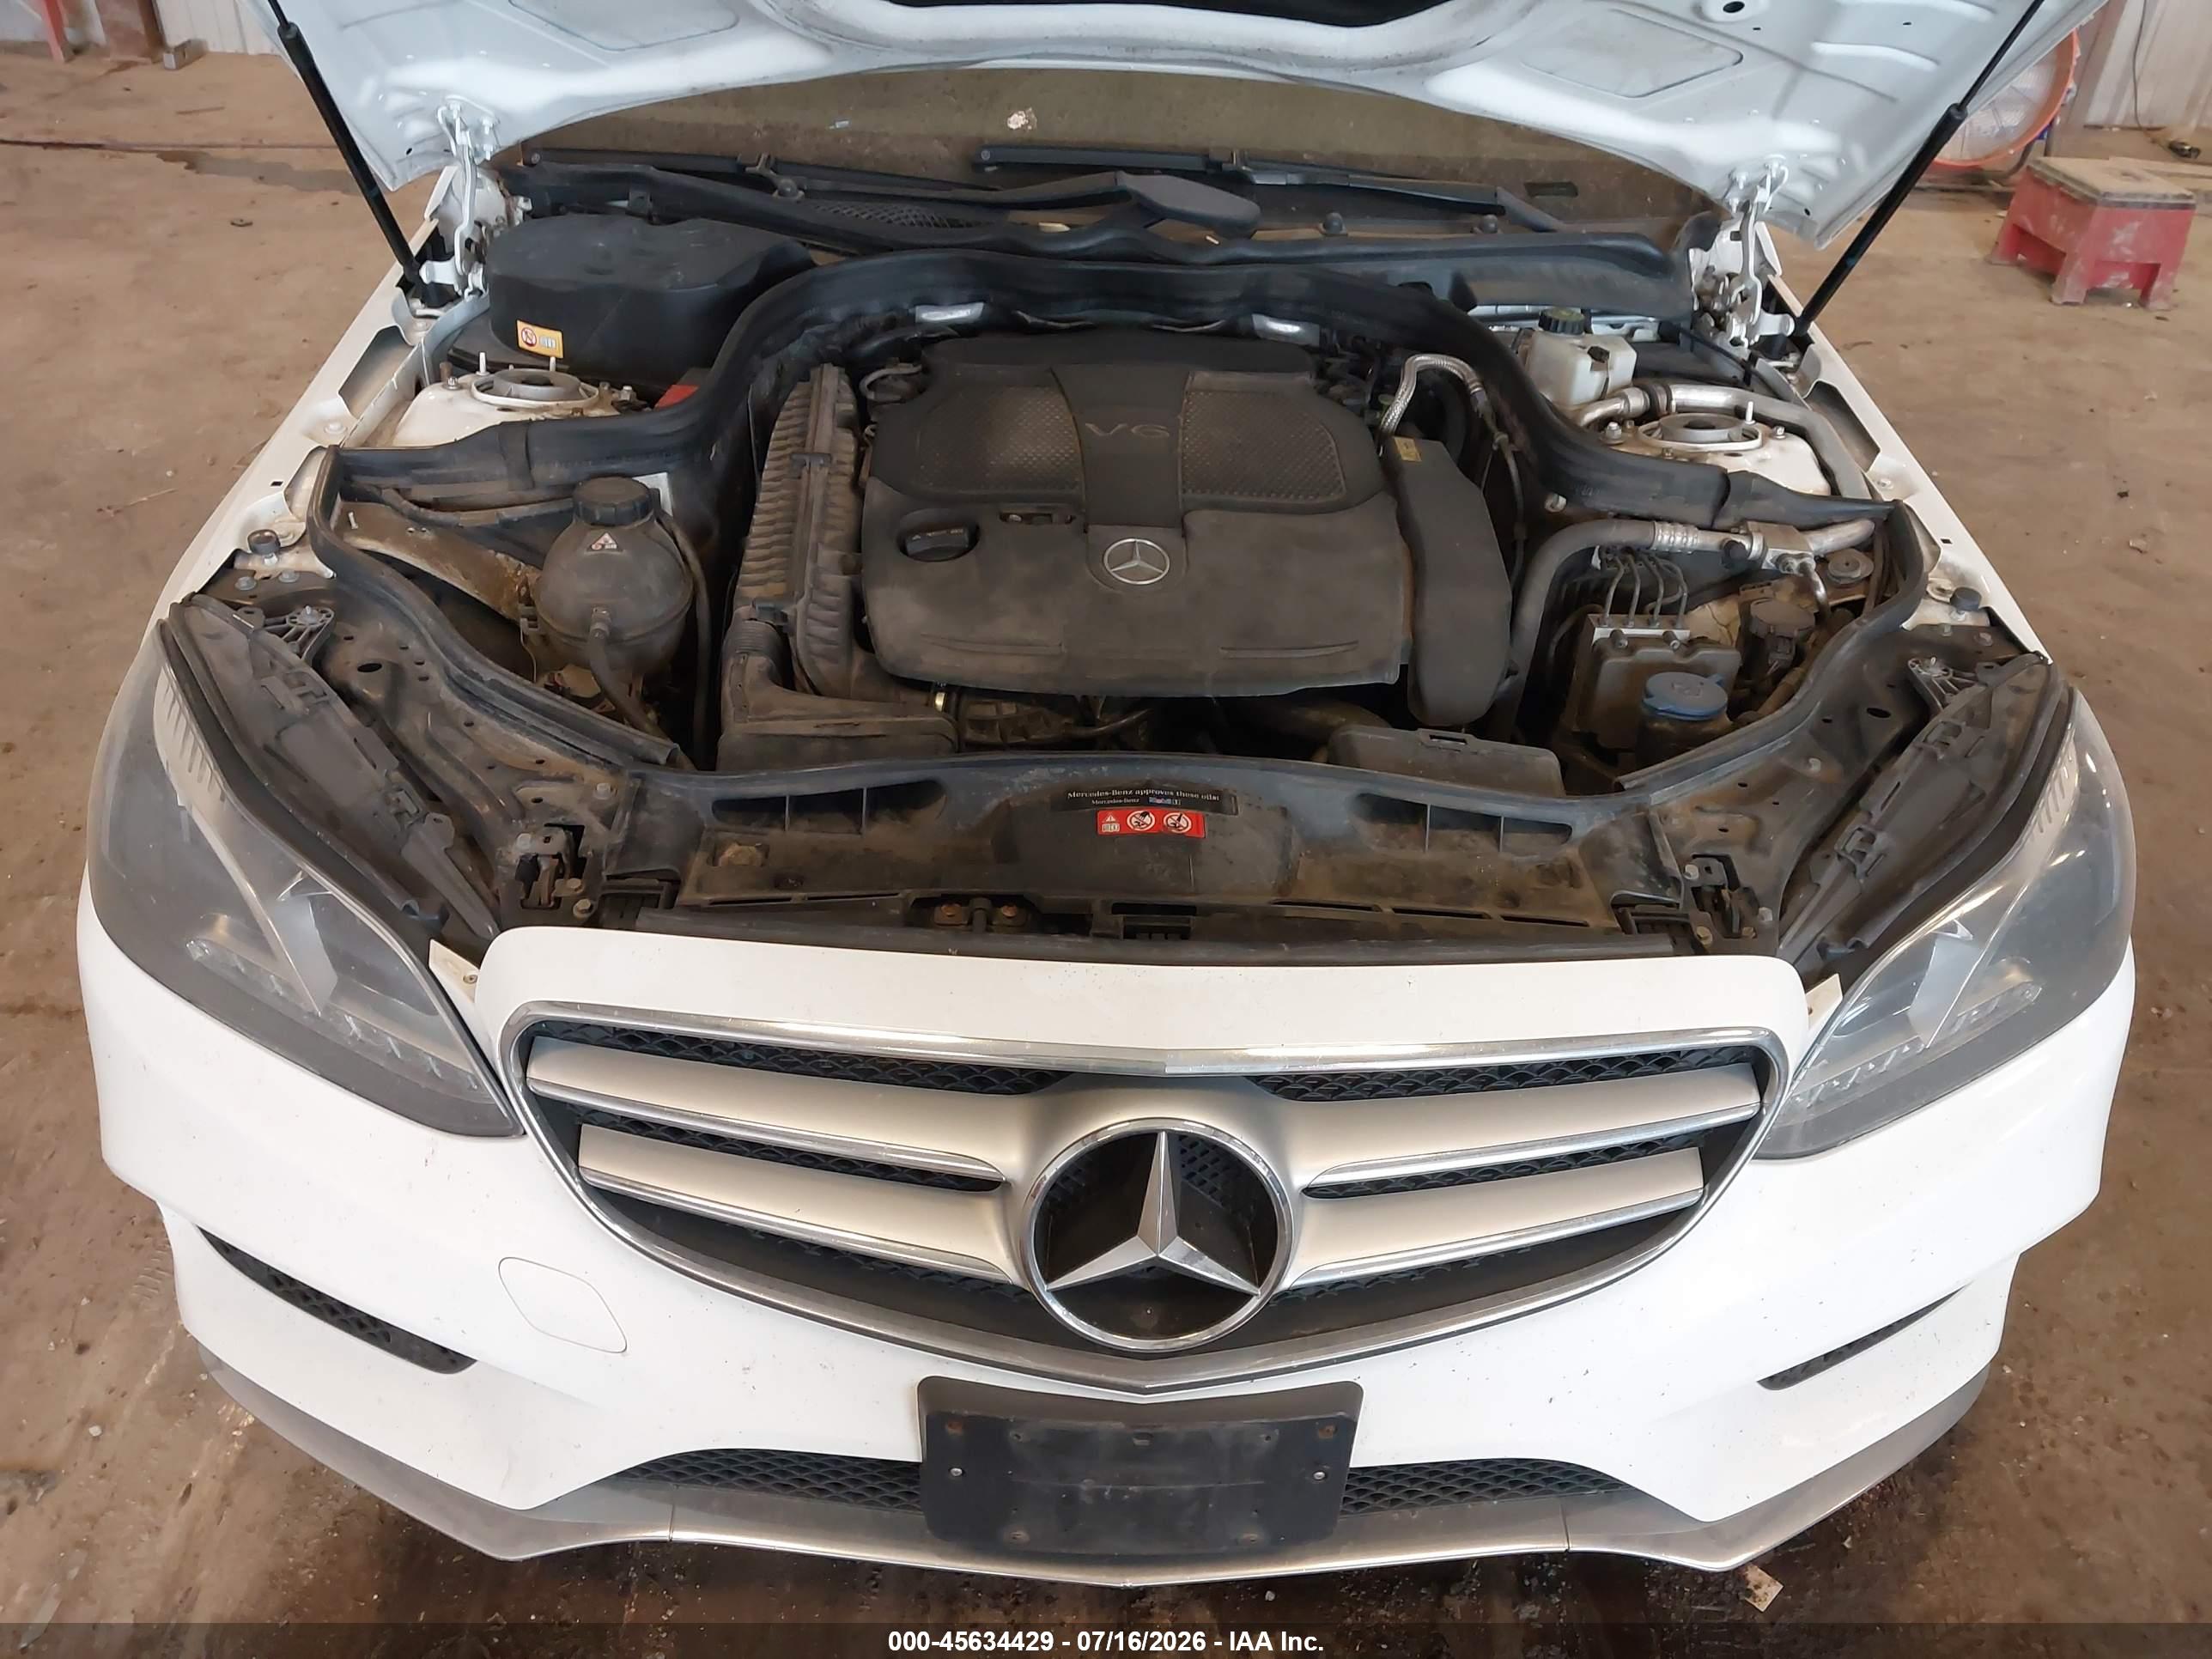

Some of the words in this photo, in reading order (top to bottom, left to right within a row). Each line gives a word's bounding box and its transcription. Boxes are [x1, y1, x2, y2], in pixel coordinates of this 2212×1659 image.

[1085, 422, 1170, 439] V6
[1067, 788, 1133, 799] Mercedes-Benz
[1135, 788, 1174, 797] approves
[1176, 790, 1199, 799] these
